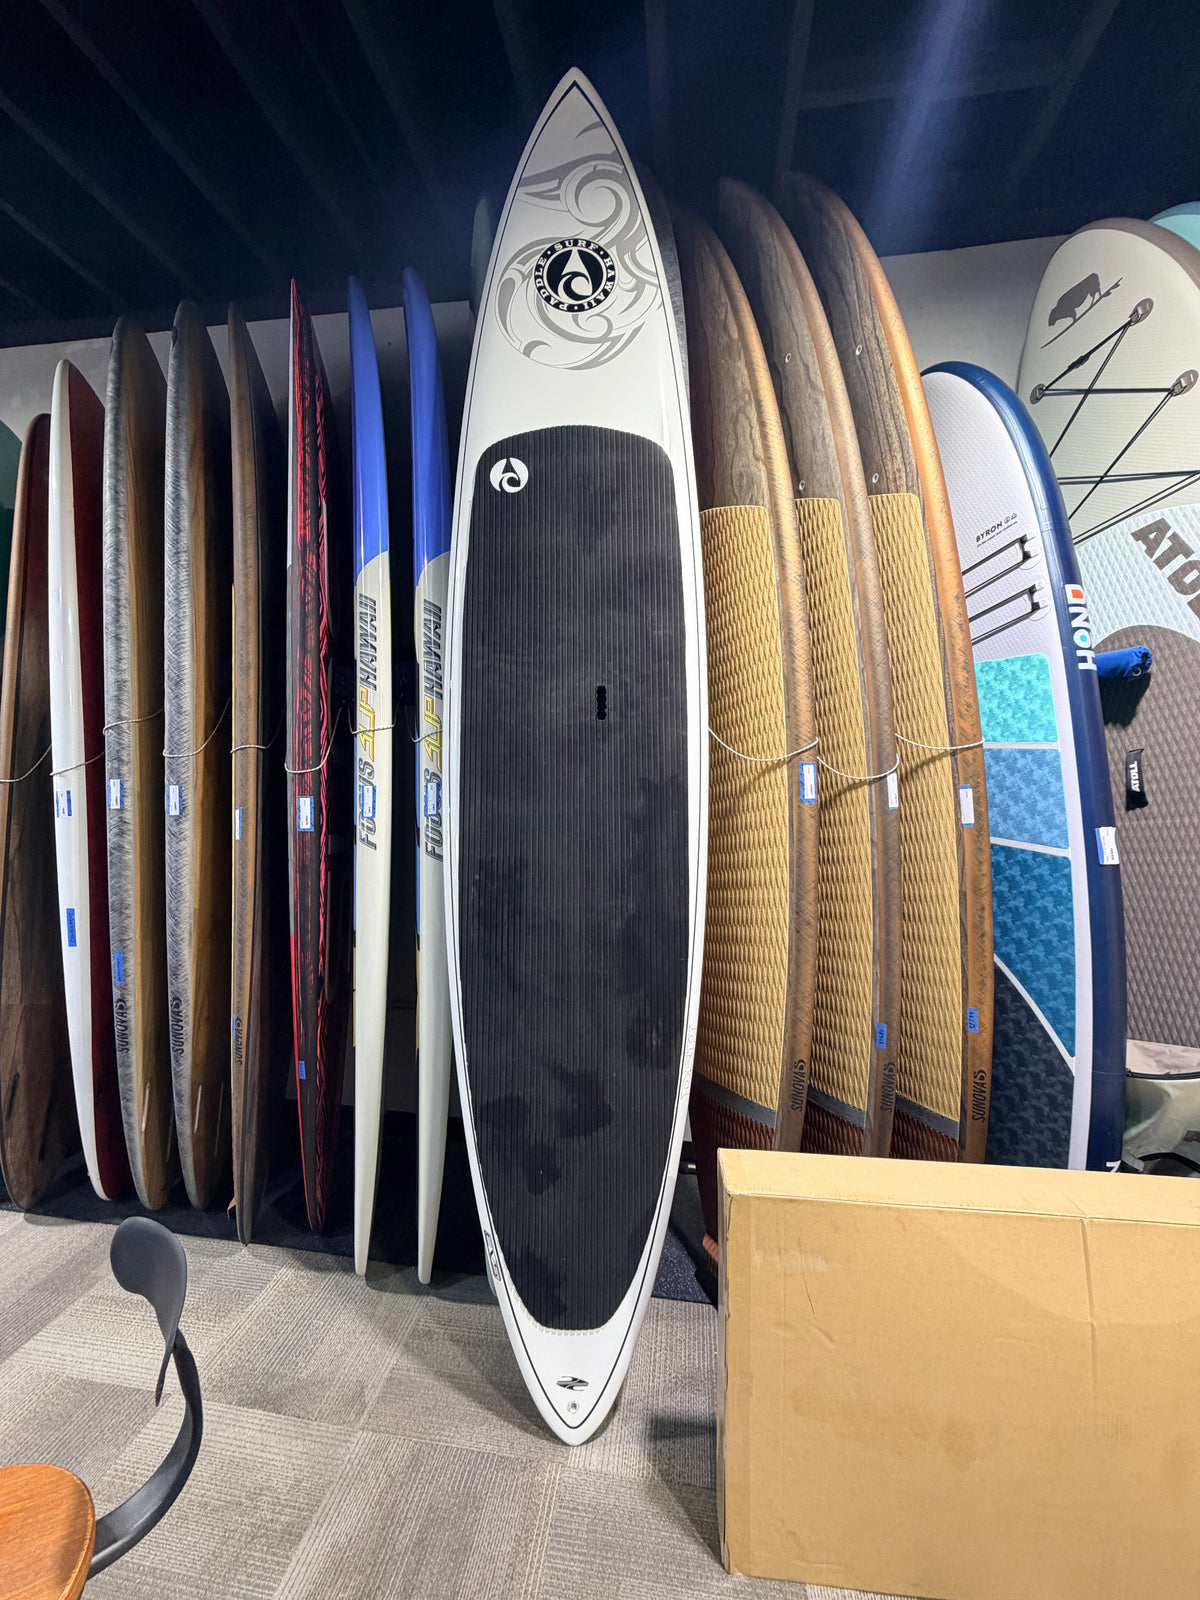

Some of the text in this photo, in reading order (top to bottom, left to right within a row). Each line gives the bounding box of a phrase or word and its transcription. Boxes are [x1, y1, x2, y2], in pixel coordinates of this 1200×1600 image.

[554, 239, 599, 252] SURF
[535, 256, 568, 311] PADDLE
[583, 257, 615, 308] HAWAII
[976, 521, 1002, 542] BYRON
[1130, 517, 1200, 620] ATO
[359, 593, 377, 691] HAWAII
[423, 599, 443, 700] HAWAII
[1065, 584, 1097, 670] HONU
[1129, 761, 1141, 792] ATOLL
[359, 758, 377, 850] FOUS
[424, 768, 443, 862] FOS
[115, 1009, 129, 1053] SUNOVA
[171, 1009, 184, 1054] SUNOVA
[792, 1073, 805, 1112] SUNOVA
[880, 1073, 895, 1112] SUNOVA
[972, 1081, 986, 1123] SUNOVA
